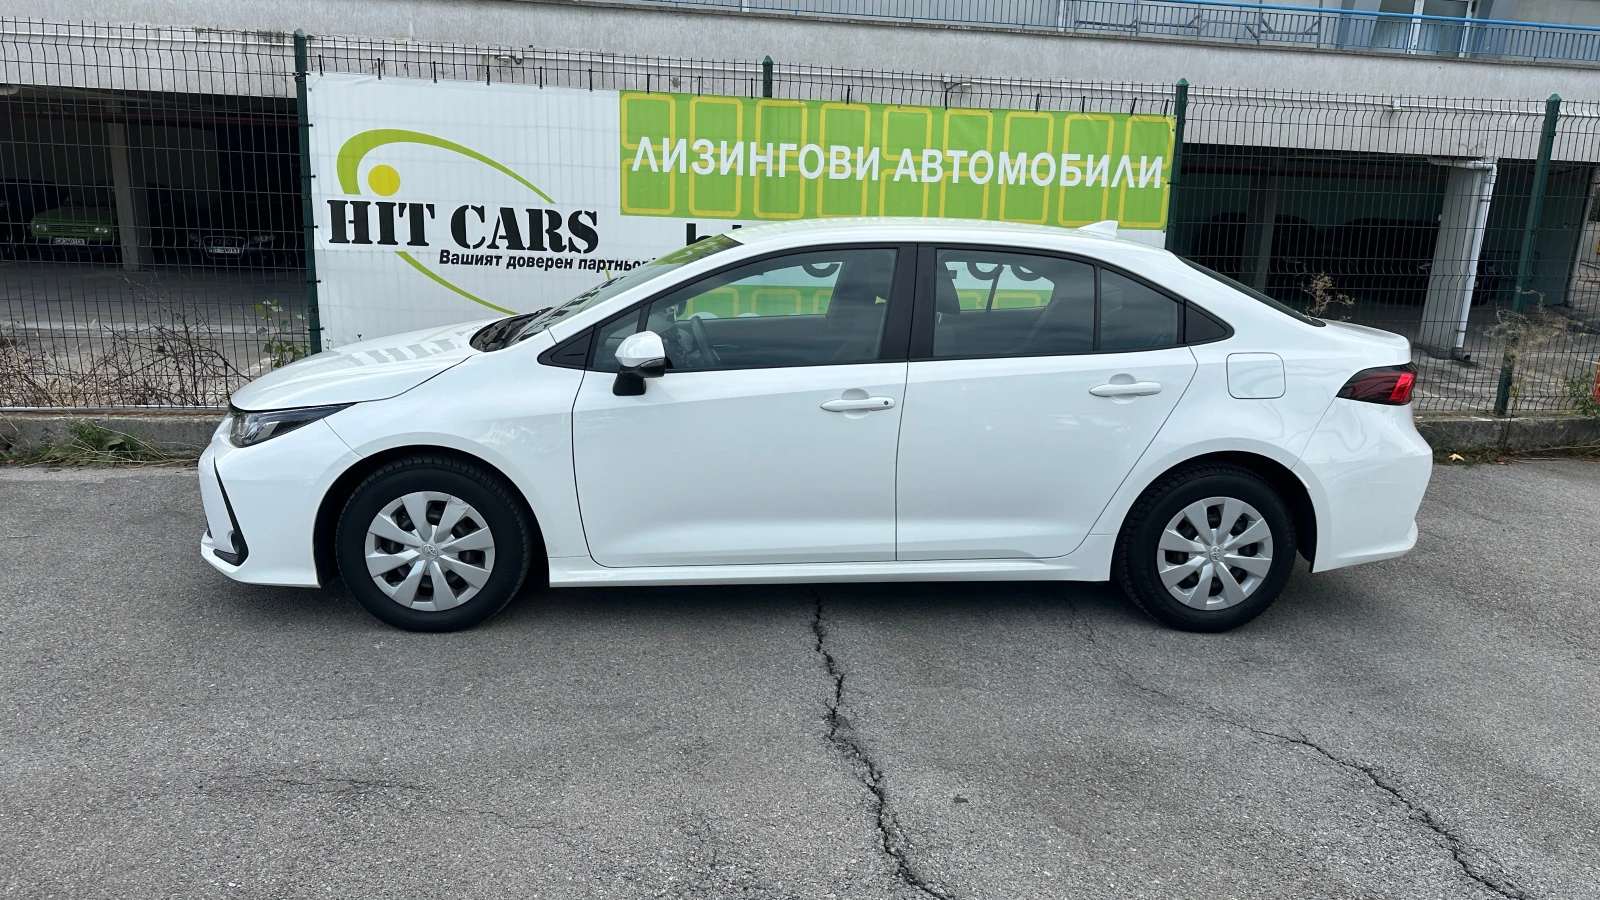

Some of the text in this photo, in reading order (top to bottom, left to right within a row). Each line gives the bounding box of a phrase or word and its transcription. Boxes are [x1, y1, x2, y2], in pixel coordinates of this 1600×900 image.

[631, 135, 1164, 189] ЛИЗИНГОВИ АВТОМОБИЛИ
[326, 199, 599, 254] HIT CARS
[438, 249, 503, 267] Вашият
[505, 255, 574, 272] доверен
